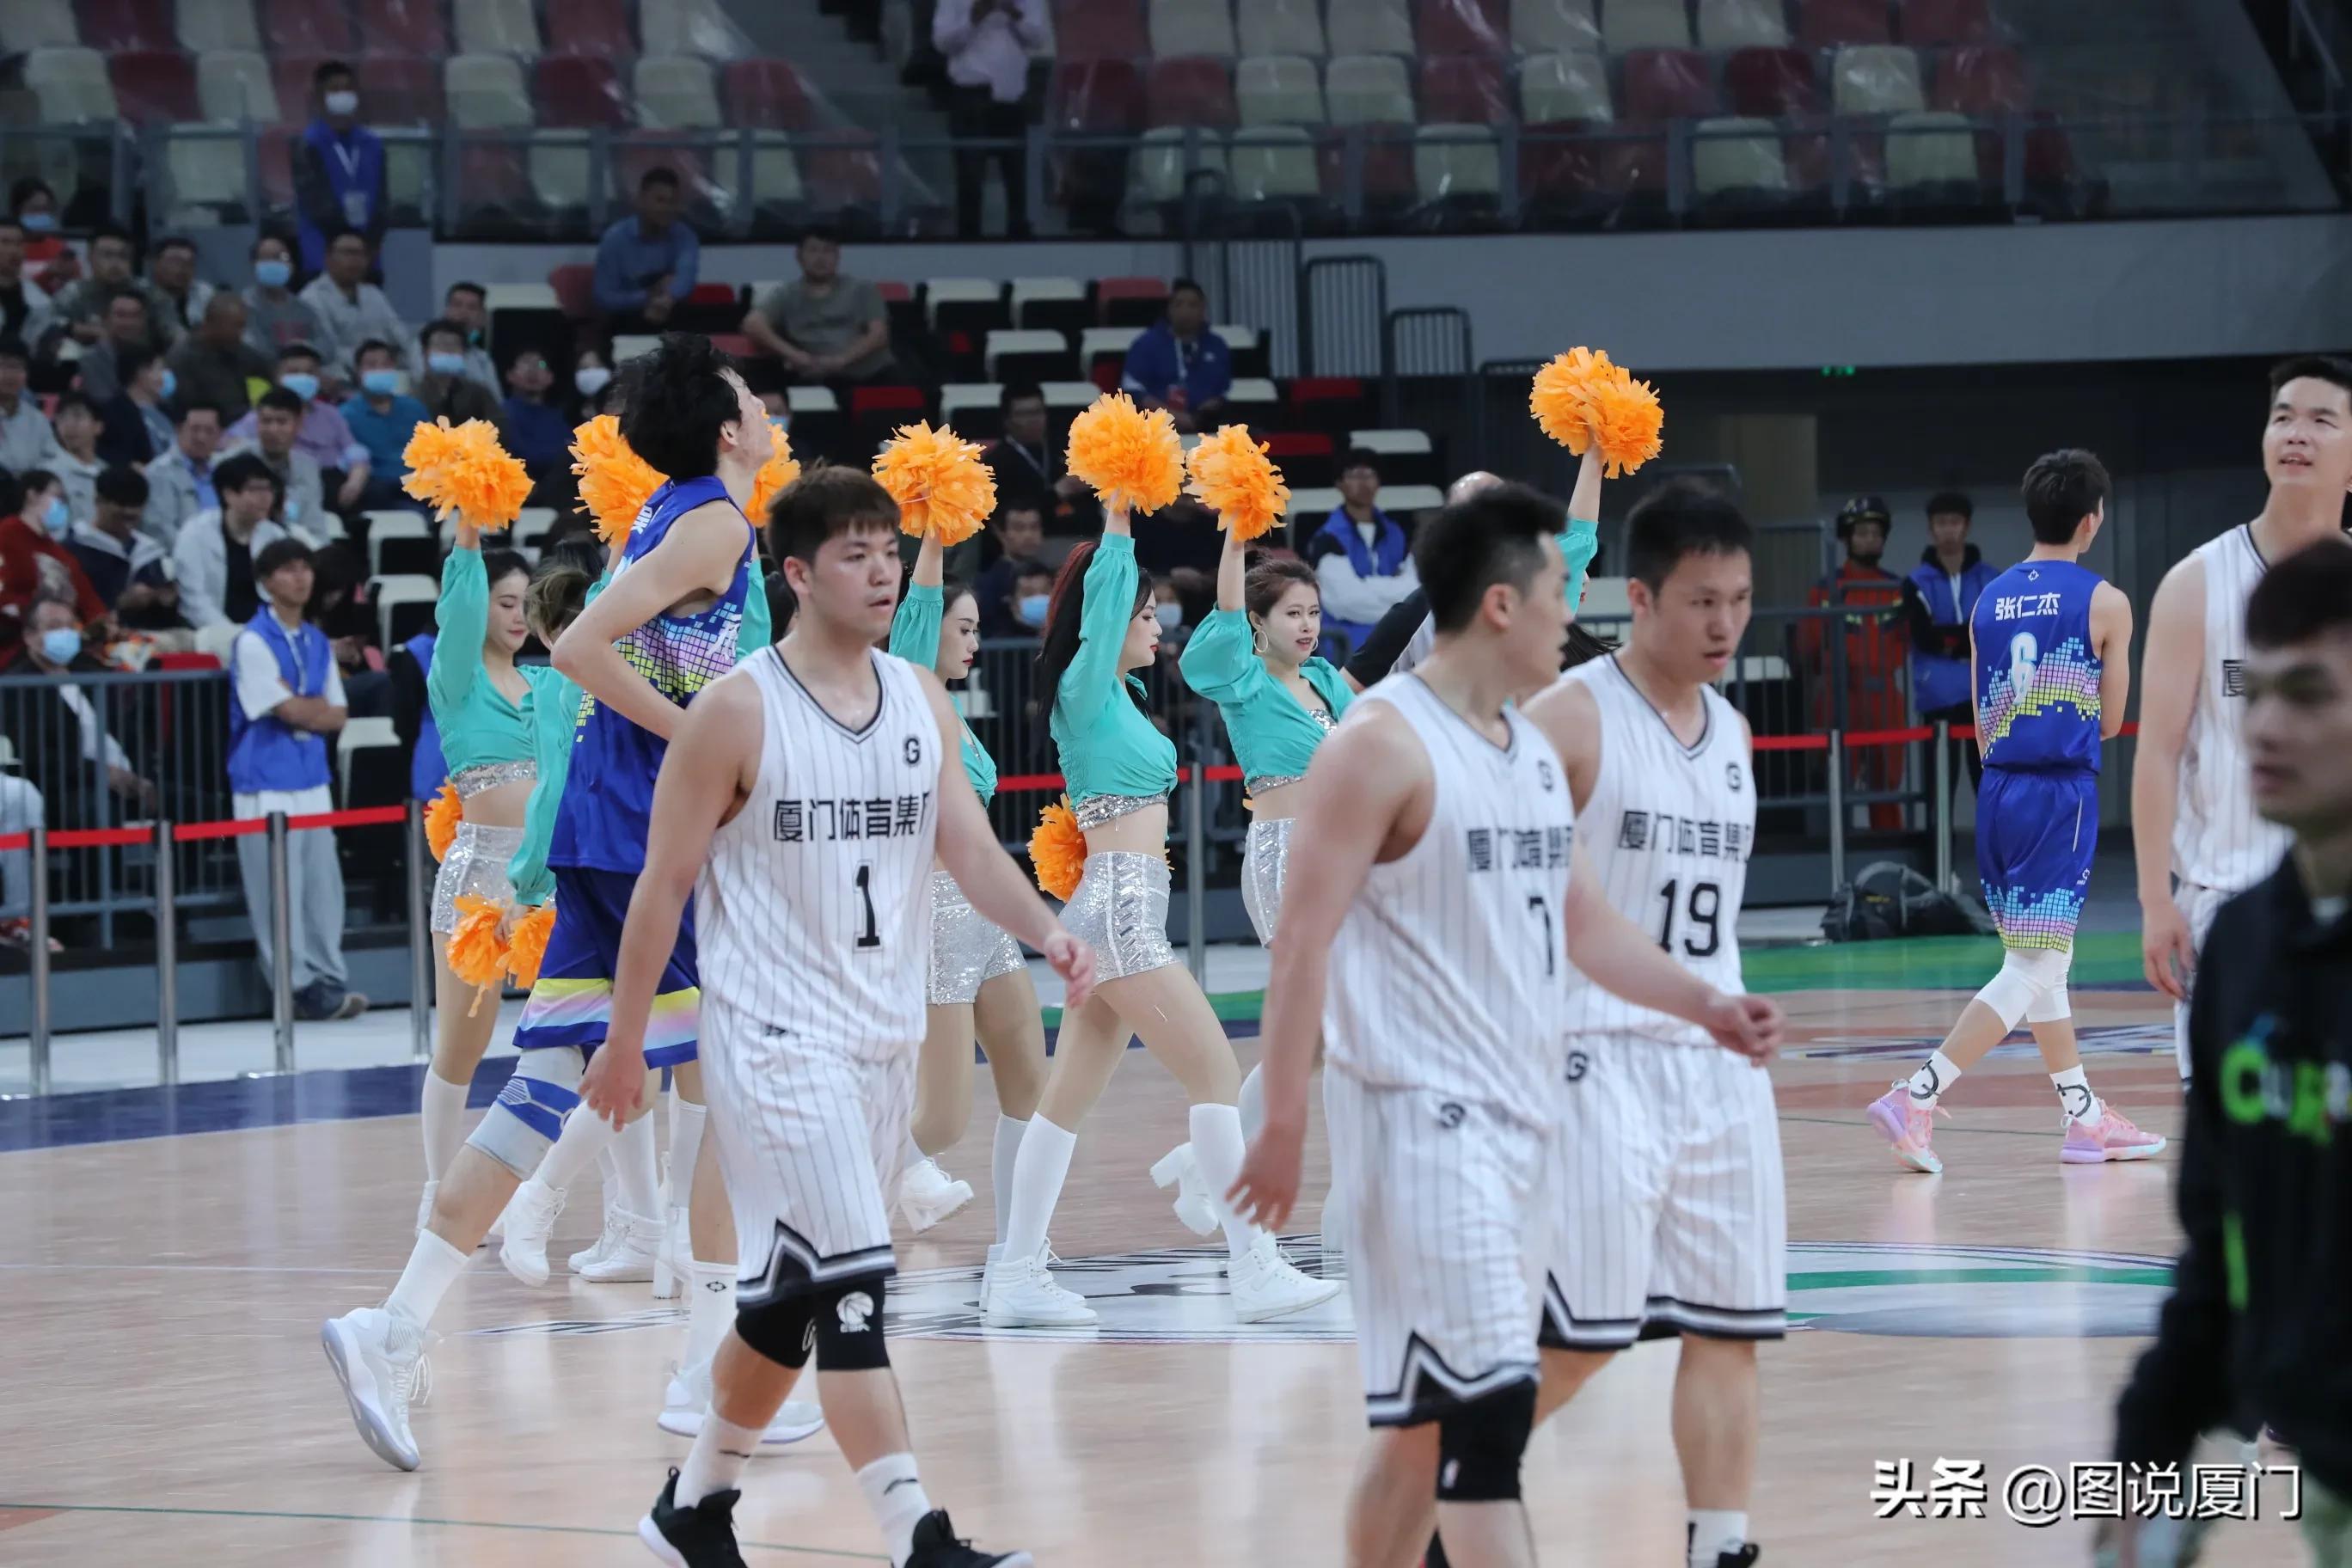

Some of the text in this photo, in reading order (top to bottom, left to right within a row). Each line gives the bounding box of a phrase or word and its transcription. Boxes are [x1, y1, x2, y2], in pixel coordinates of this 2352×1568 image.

[1995, 592, 2061, 621] 张仁杰
[1617, 810, 1751, 862] 厦门体育集
[854, 863, 882, 948] 1
[1657, 878, 1721, 958] 19
